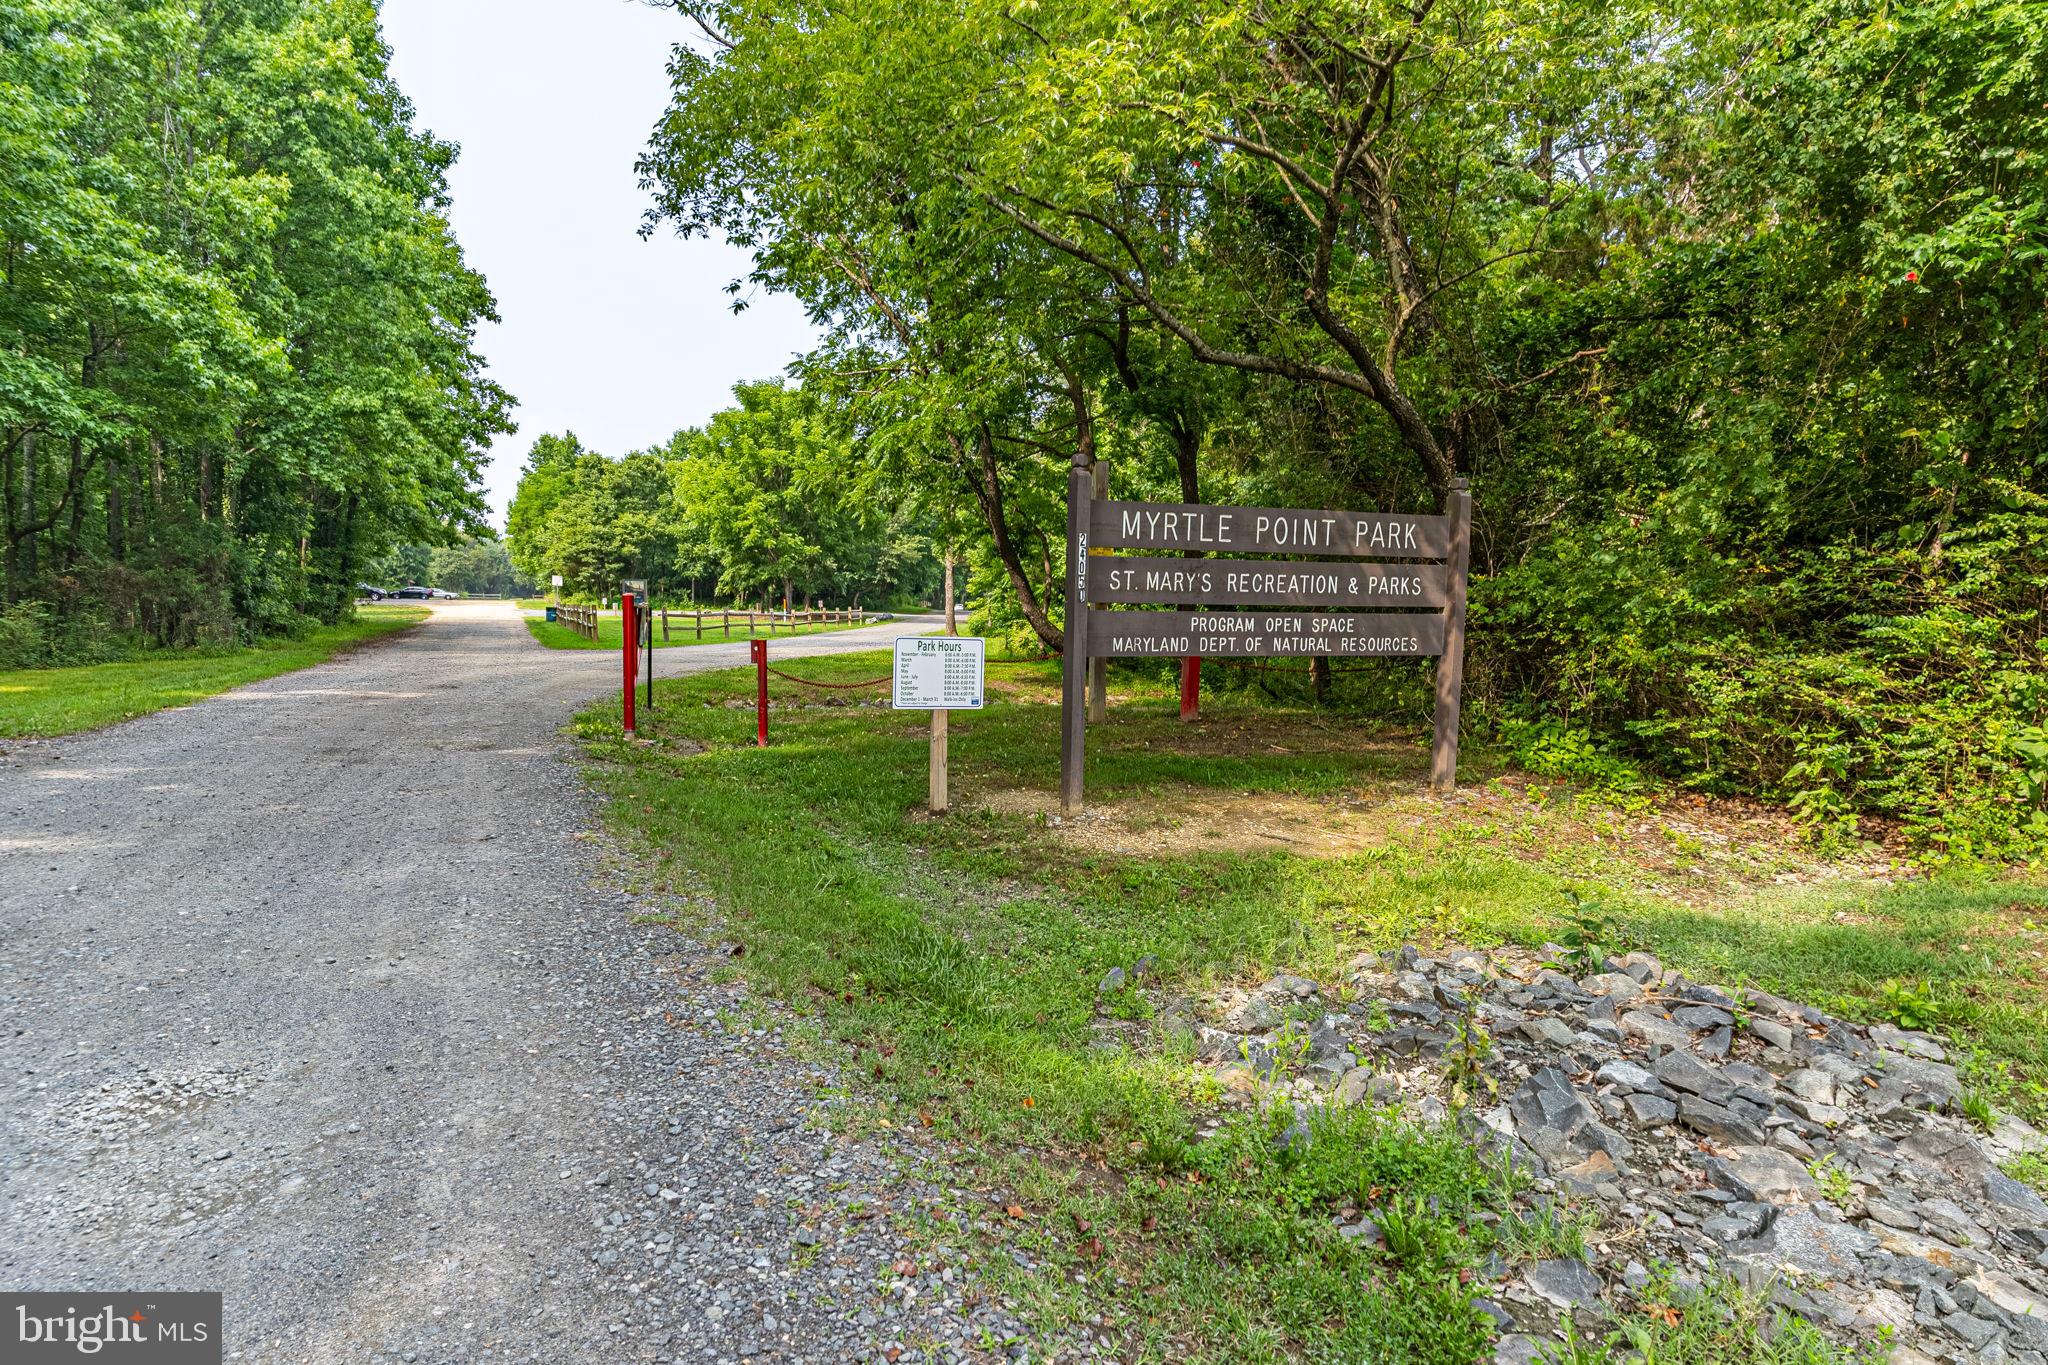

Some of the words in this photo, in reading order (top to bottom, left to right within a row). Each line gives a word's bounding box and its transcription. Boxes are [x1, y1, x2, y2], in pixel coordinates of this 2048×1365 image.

[1122, 510, 1233, 543] MYRTLE
[1256, 516, 1336, 547] POINT
[1355, 520, 1417, 550] PARK
[1109, 570, 1138, 591] ST.
[1146, 571, 1212, 593] MARY'S
[1227, 572, 1338, 594] RECREATION
[1348, 576, 1359, 595] &
[1368, 576, 1422, 596] PARKS
[1190, 616, 1255, 633] PROGRAM
[1265, 617, 1302, 633] OPEN
[1311, 617, 1355, 633] SPACE
[918, 640, 936, 652] Park
[938, 641, 961, 652] Hours
[1112, 636, 1189, 653] MARYLAND
[1199, 636, 1239, 652] DEPT.
[1245, 636, 1263, 652] OF
[1273, 637, 1332, 652] NATURAL
[1341, 637, 1418, 652] RESOURCES
